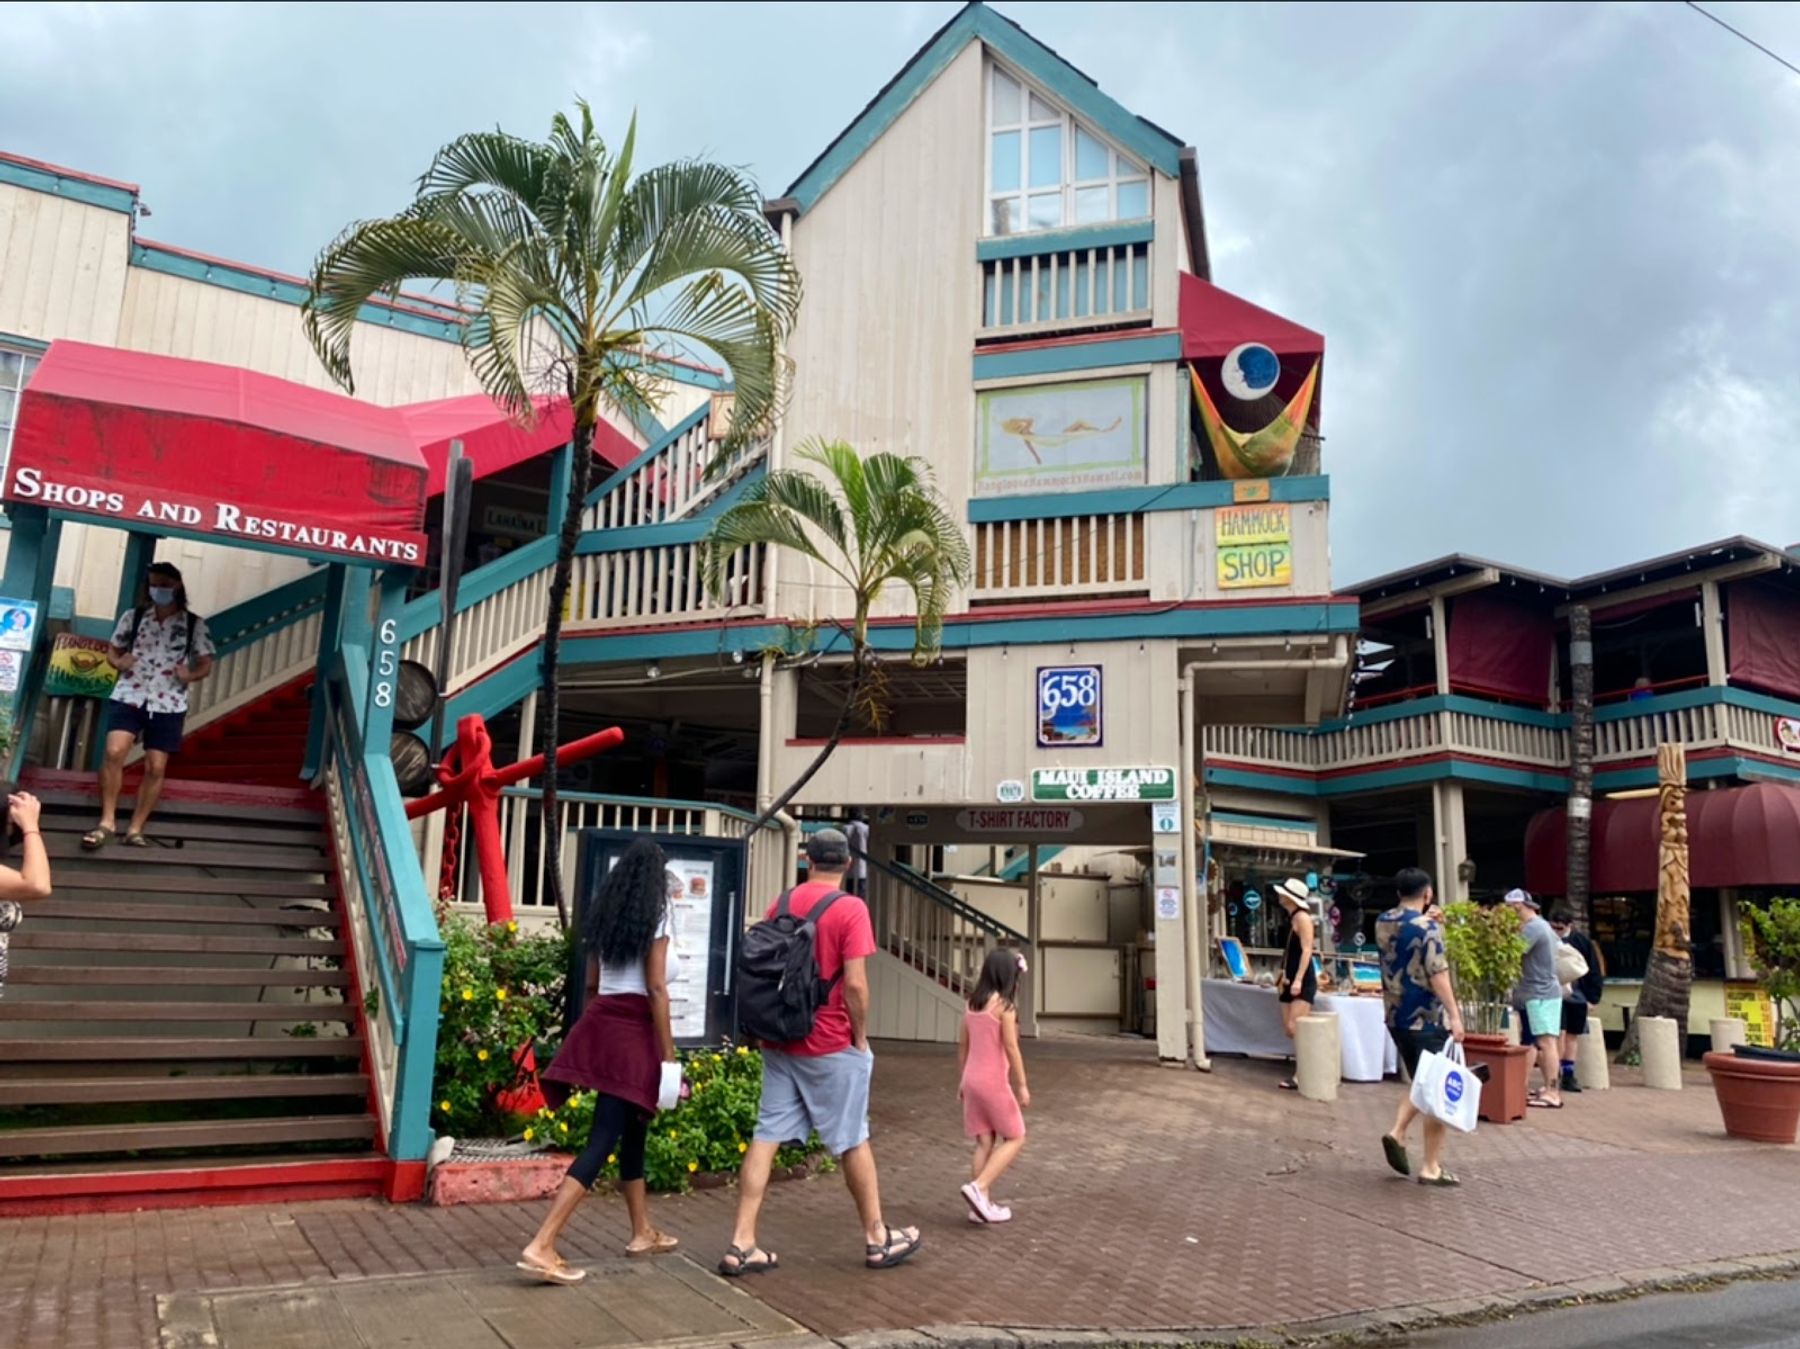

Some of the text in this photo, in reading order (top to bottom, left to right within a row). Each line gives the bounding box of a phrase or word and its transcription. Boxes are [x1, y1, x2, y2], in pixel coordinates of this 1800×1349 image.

[13, 467, 419, 561] SHOPS AND RESTAURANTS
[1221, 507, 1286, 536] HAMMOCK
[1223, 549, 1286, 581] SHOP
[1043, 674, 1096, 708] 658
[1038, 768, 1169, 785] MAUI ISLAND
[1065, 784, 1141, 800] COFFEE
[968, 810, 1071, 828] T-SHIRT FACTORY
